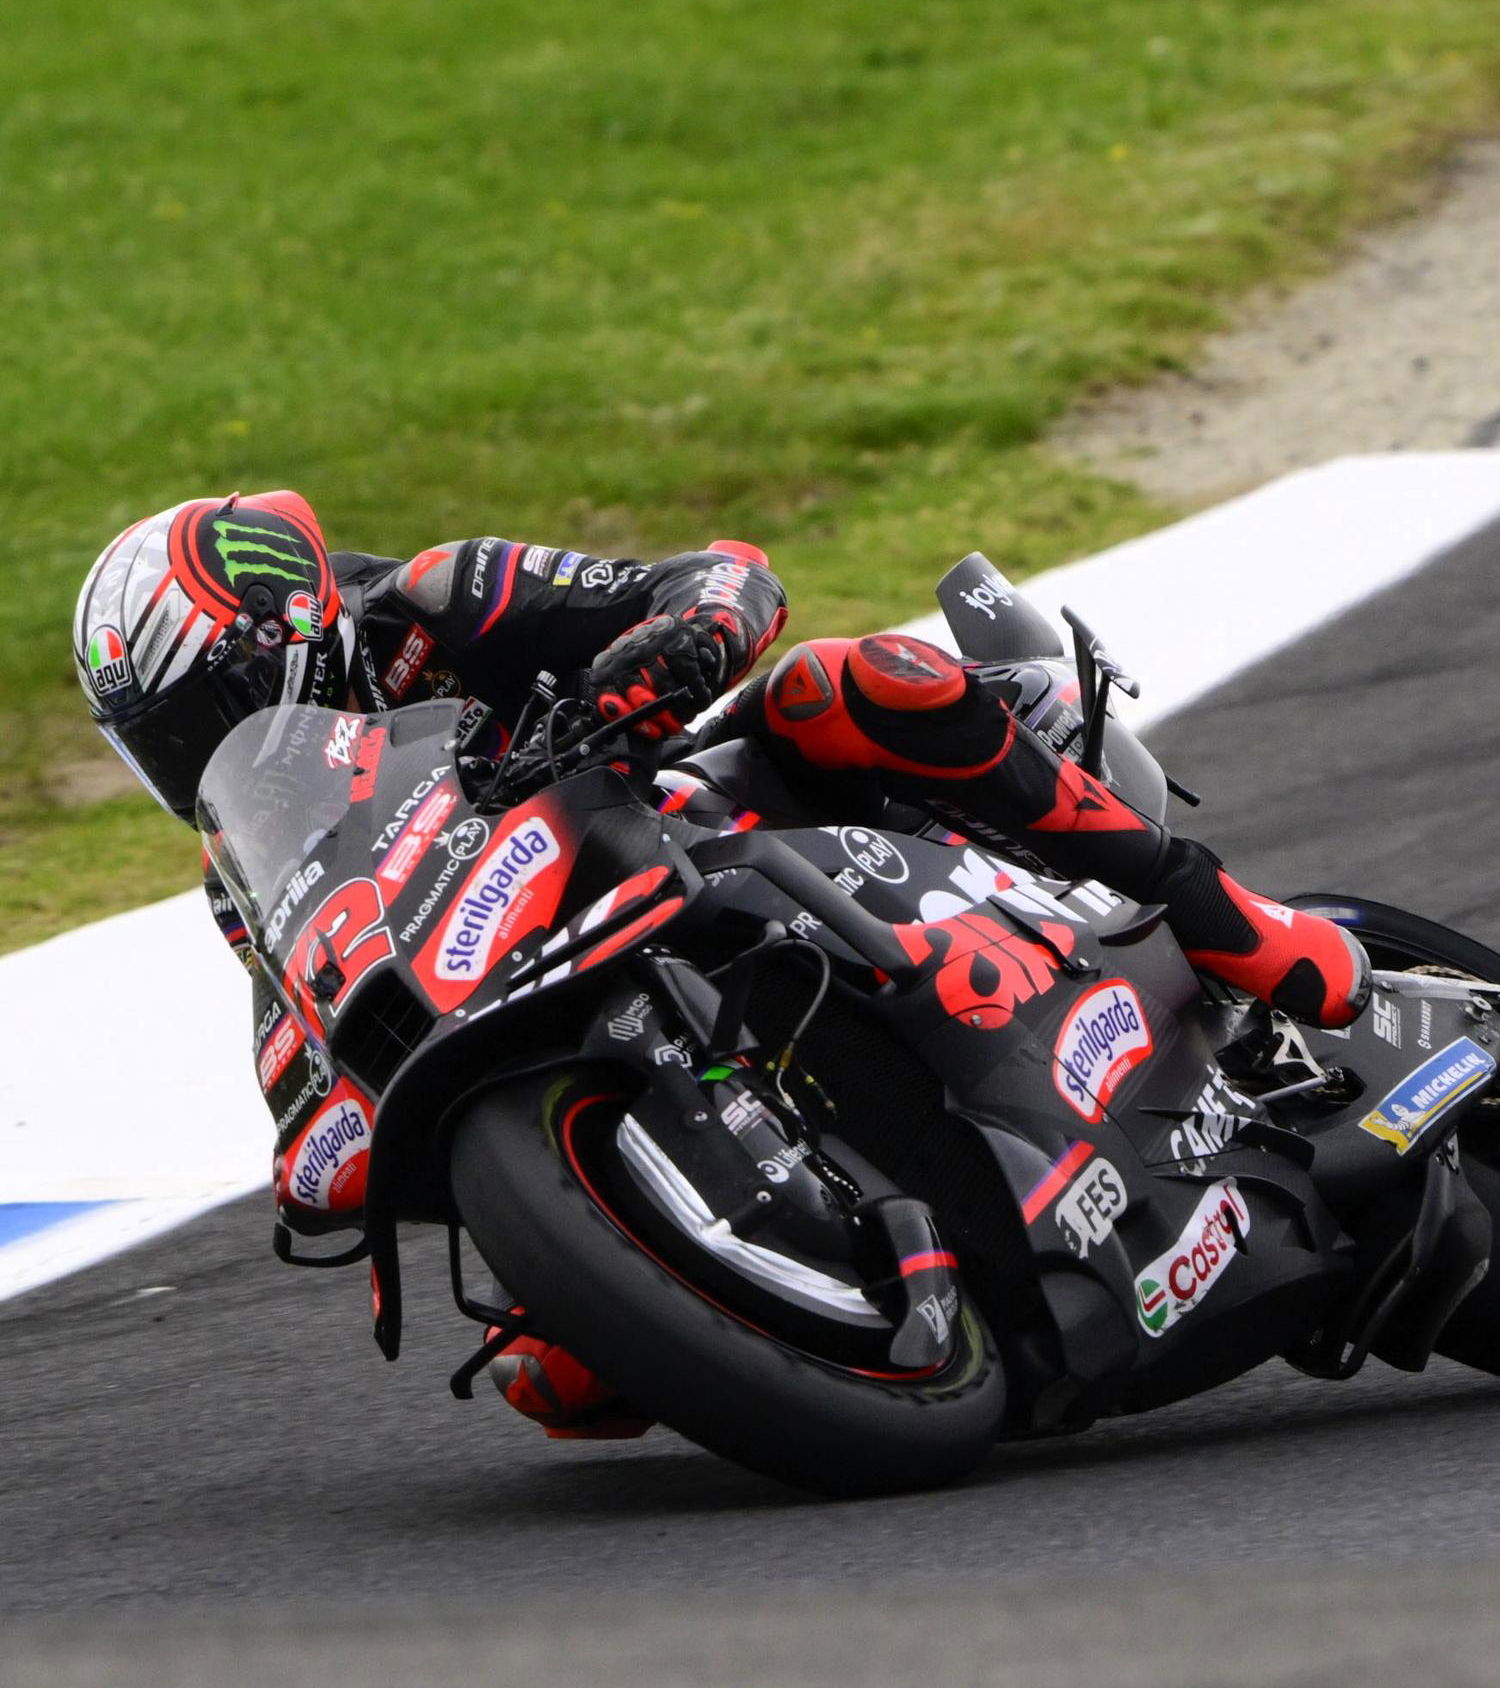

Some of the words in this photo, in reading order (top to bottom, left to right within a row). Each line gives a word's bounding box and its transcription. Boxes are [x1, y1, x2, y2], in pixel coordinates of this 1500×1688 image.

[95, 659, 126, 689] agv
[371, 765, 452, 852] TARGA
[857, 837, 897, 872] PLAY
[264, 860, 326, 954] aprilia
[399, 858, 460, 943] PRAGMATIC
[455, 822, 483, 856] PLAY
[446, 829, 549, 973] sterilgarda
[498, 887, 535, 940] alimenti
[1065, 989, 1140, 1103] sterilgarda
[1410, 1052, 1487, 1109] MICHELIN
[295, 1105, 365, 1203] sterilgarda
[1168, 1183, 1245, 1300] Castrol
